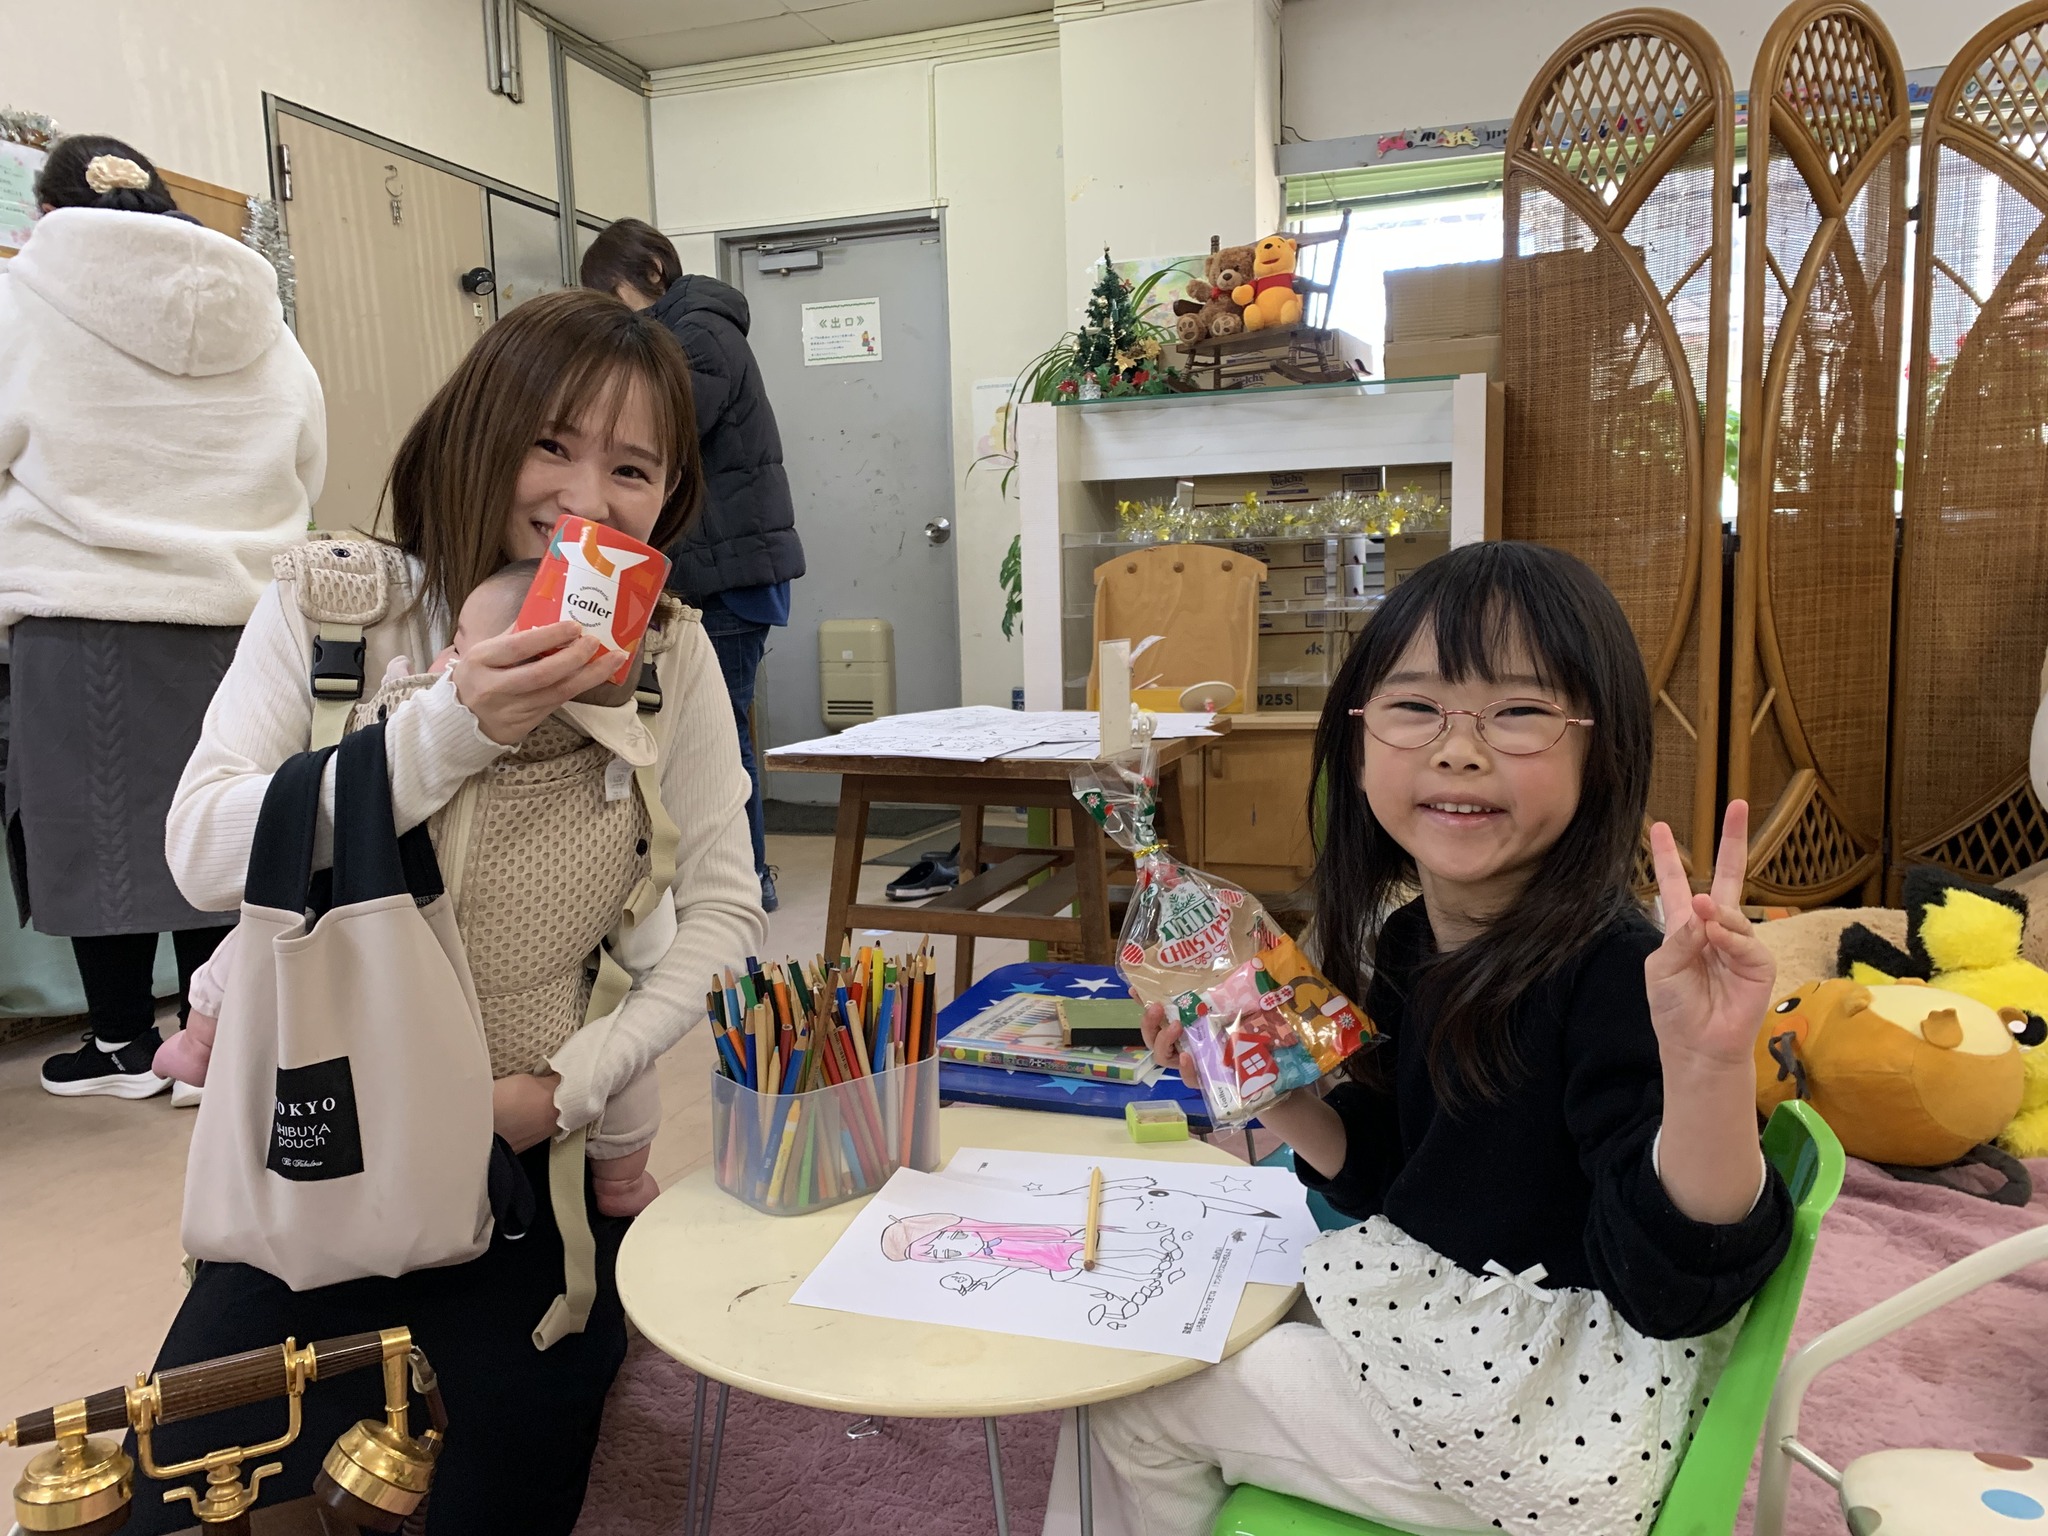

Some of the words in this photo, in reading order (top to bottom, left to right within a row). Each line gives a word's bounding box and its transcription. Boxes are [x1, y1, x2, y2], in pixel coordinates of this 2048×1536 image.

[567, 593, 612, 619] Galler
[275, 1095, 336, 1117] OKYO
[278, 1134, 326, 1149] pouch
